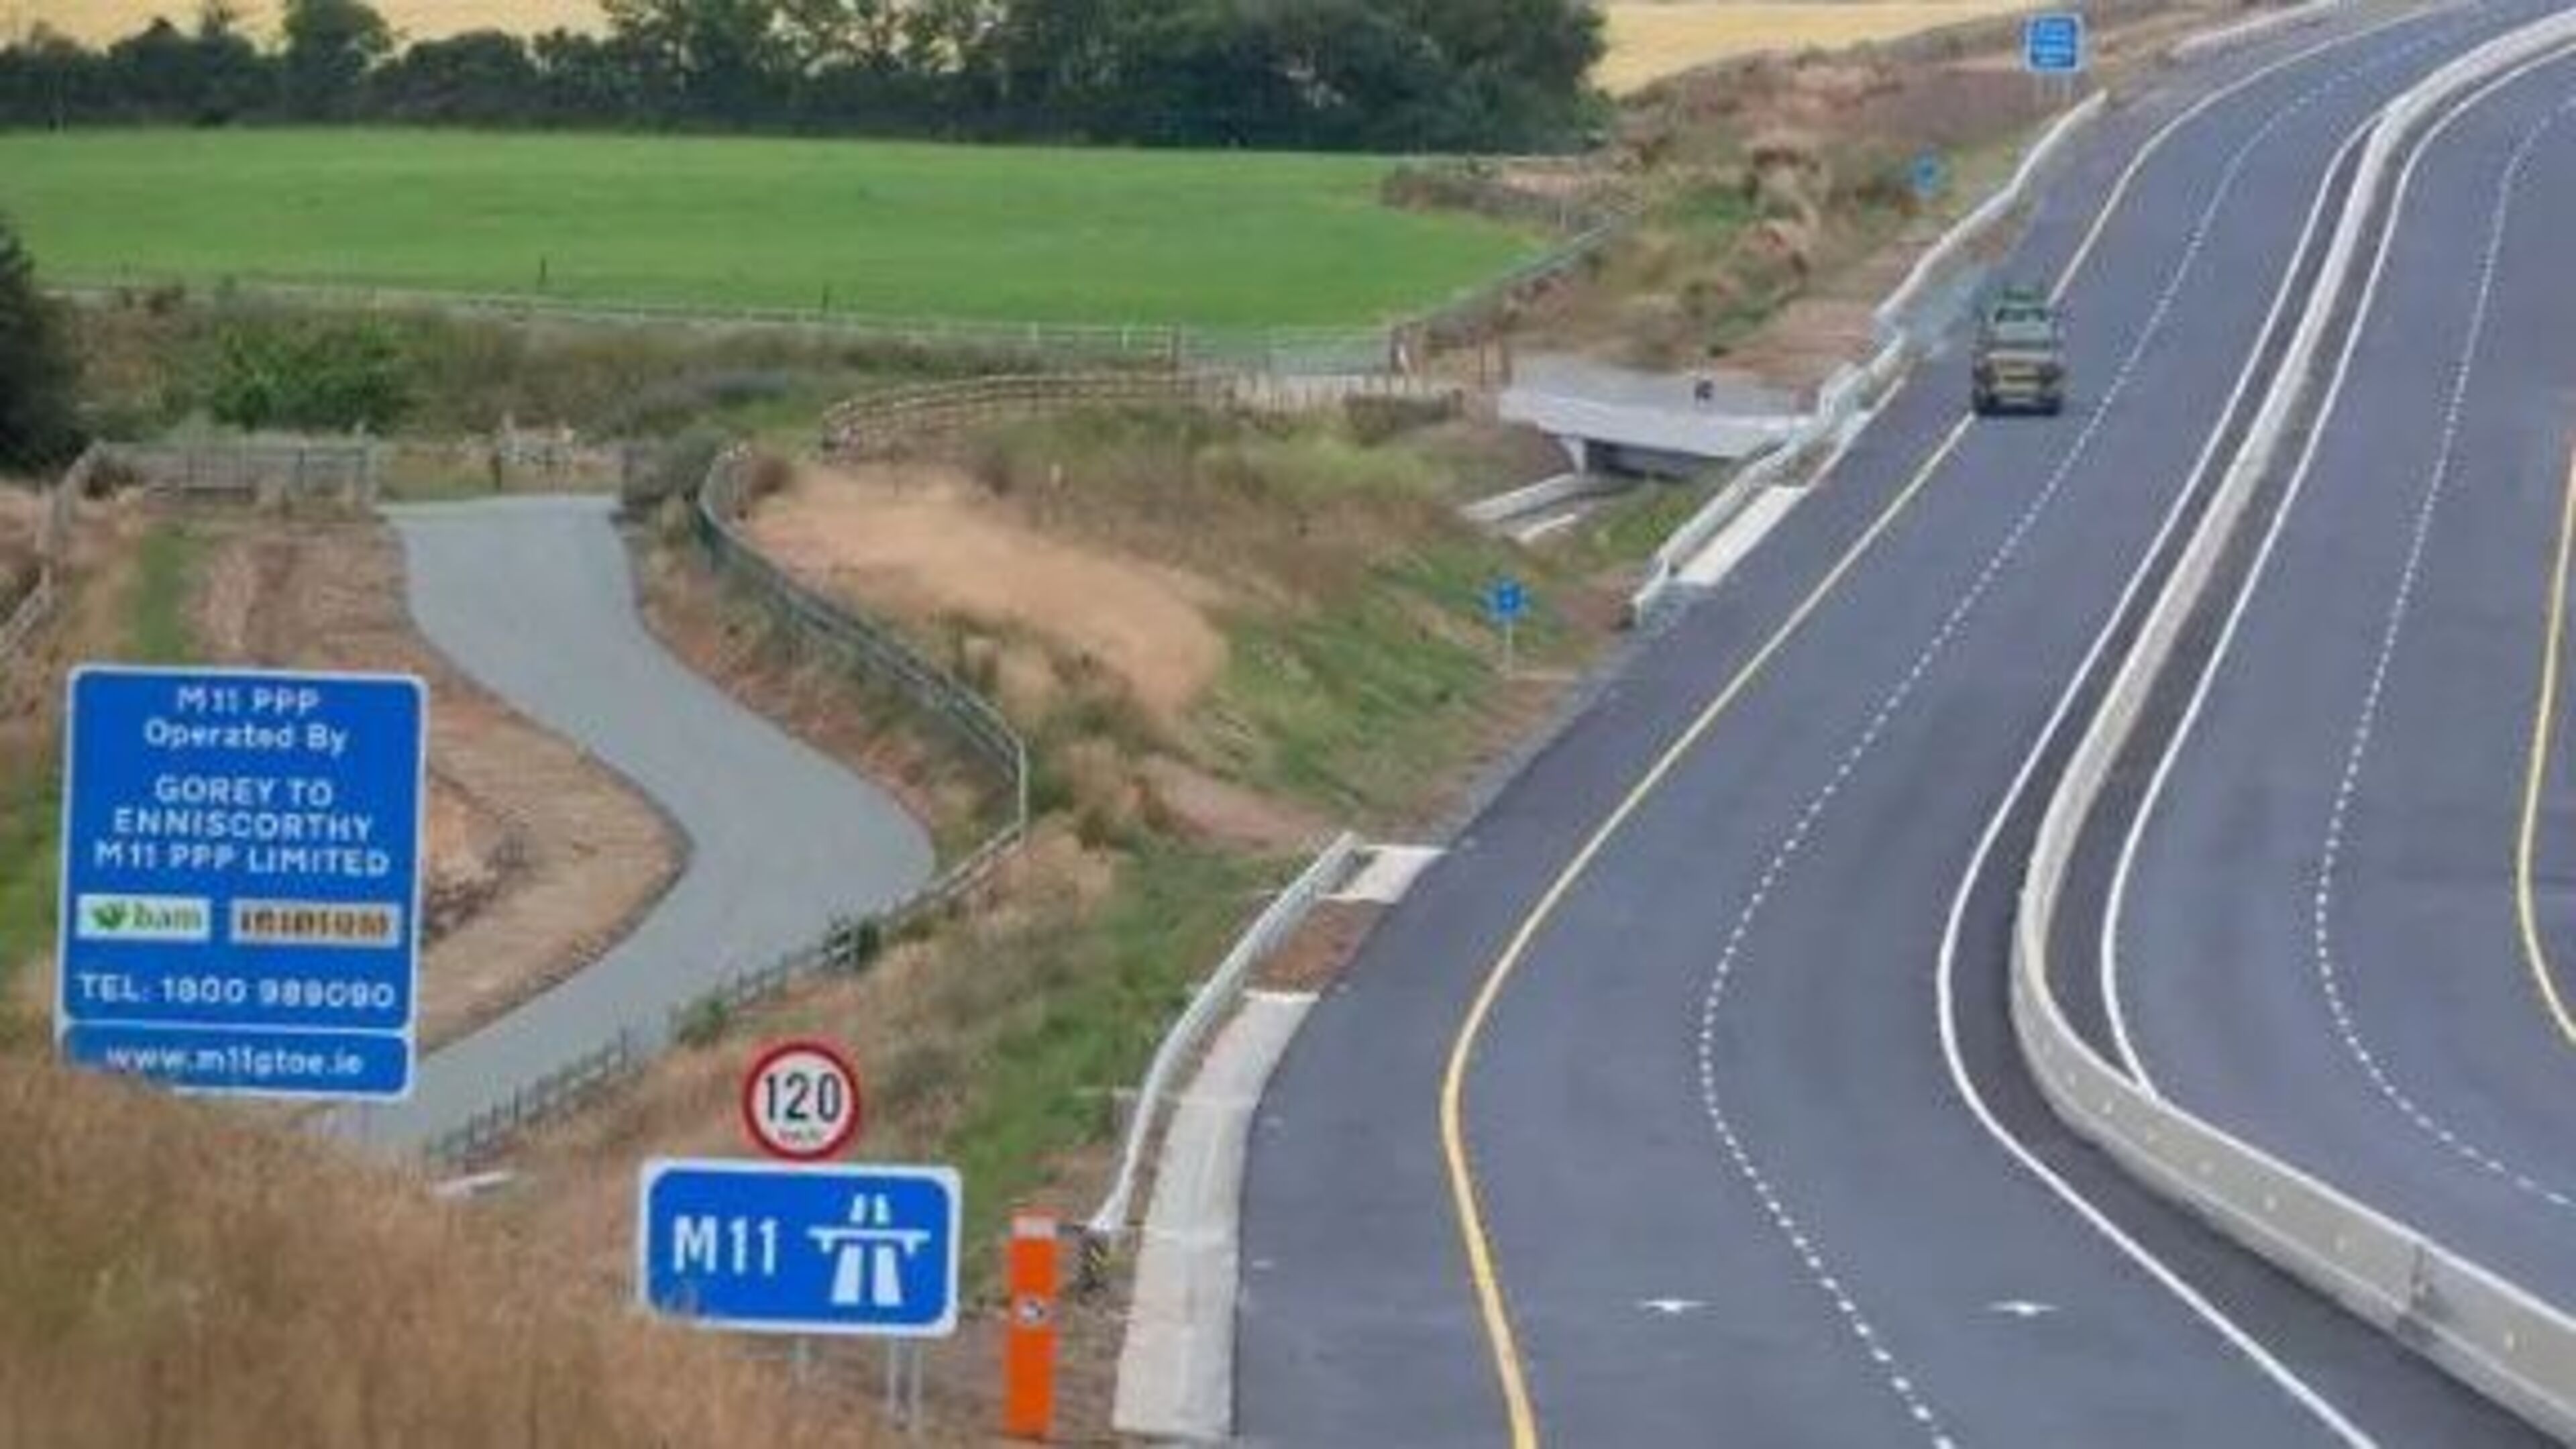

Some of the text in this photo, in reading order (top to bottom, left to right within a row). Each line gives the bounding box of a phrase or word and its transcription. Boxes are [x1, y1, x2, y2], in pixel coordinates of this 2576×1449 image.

[178, 687, 320, 716] M11 PPP
[144, 718, 347, 757] Operated By
[155, 775, 333, 808] GOREY TO
[113, 808, 374, 843] ENNISCORTHY
[94, 839, 390, 877] M11 PPP LIMITED
[163, 976, 246, 1004] 1800
[765, 1071, 841, 1123] 120
[673, 1215, 779, 1275] M11
